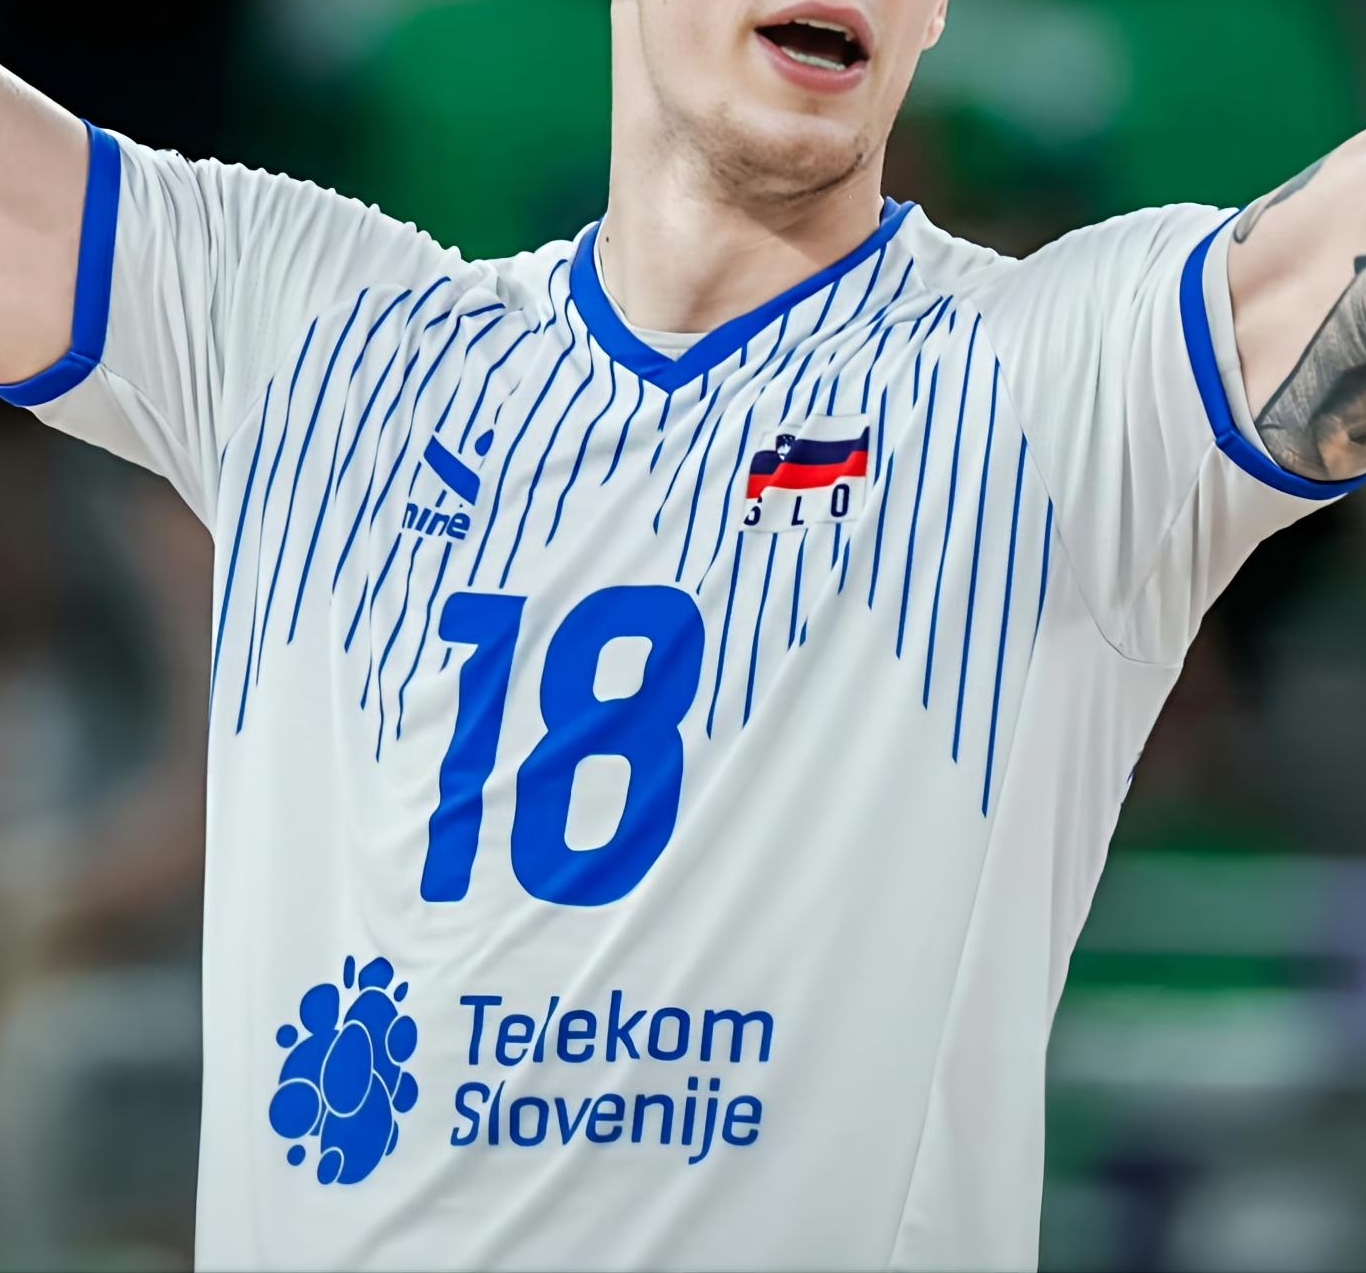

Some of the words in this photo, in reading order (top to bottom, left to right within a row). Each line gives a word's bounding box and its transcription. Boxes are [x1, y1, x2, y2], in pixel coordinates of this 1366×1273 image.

[420, 584, 707, 908] 18
[460, 989, 775, 1068] Telekom
[450, 1076, 763, 1166] Slovenije
